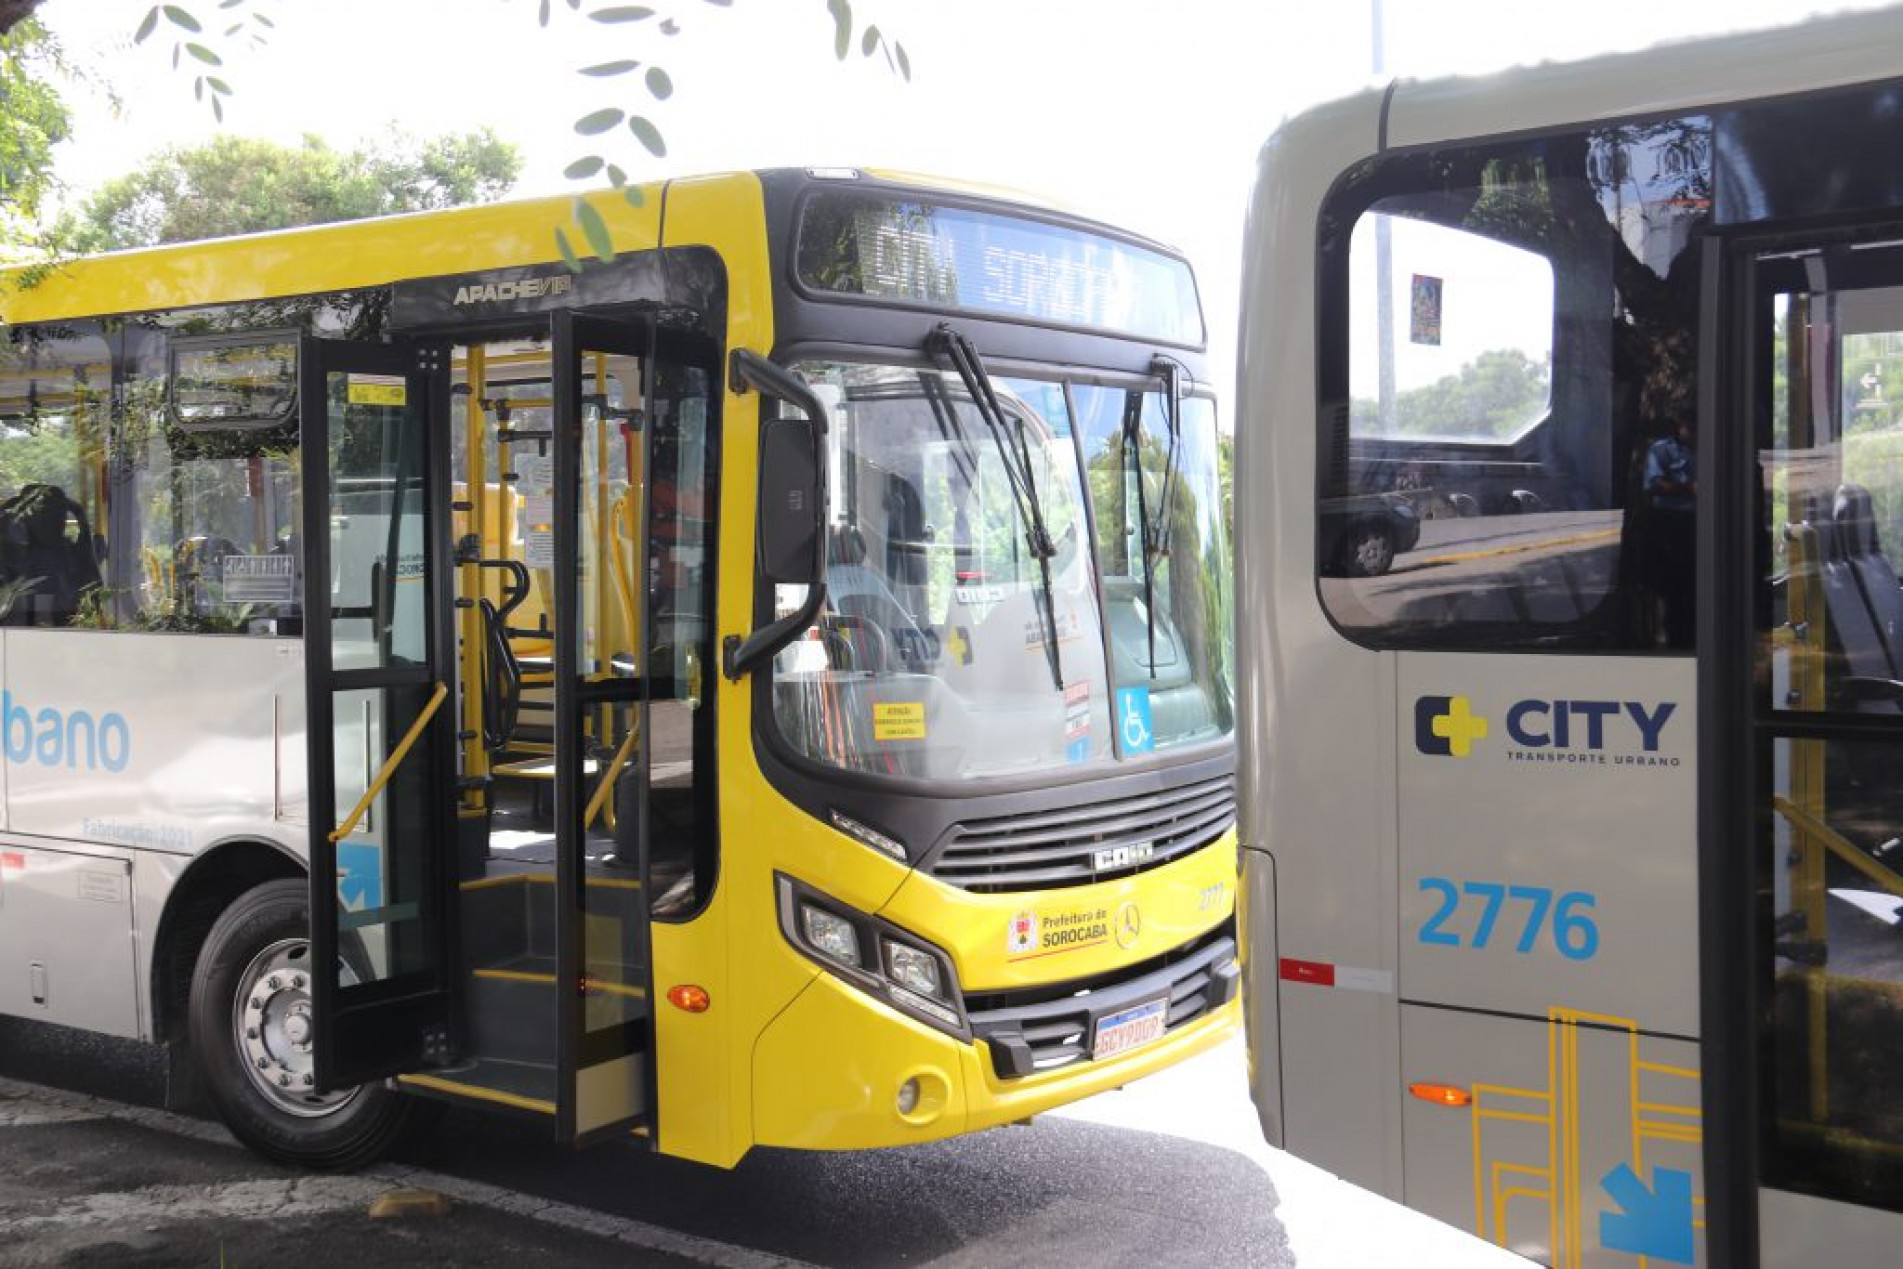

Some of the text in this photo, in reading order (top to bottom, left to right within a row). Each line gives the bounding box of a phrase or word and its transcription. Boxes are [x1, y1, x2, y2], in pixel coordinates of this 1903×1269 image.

[3, 689, 130, 773] bano
[1506, 699, 1678, 752] CITY
[1507, 751, 1681, 767] TRANSPORTE URBANO
[1042, 908, 1107, 928] Prefeitura de
[1042, 923, 1108, 948] SOROCABA
[1419, 877, 1598, 960] 2776
